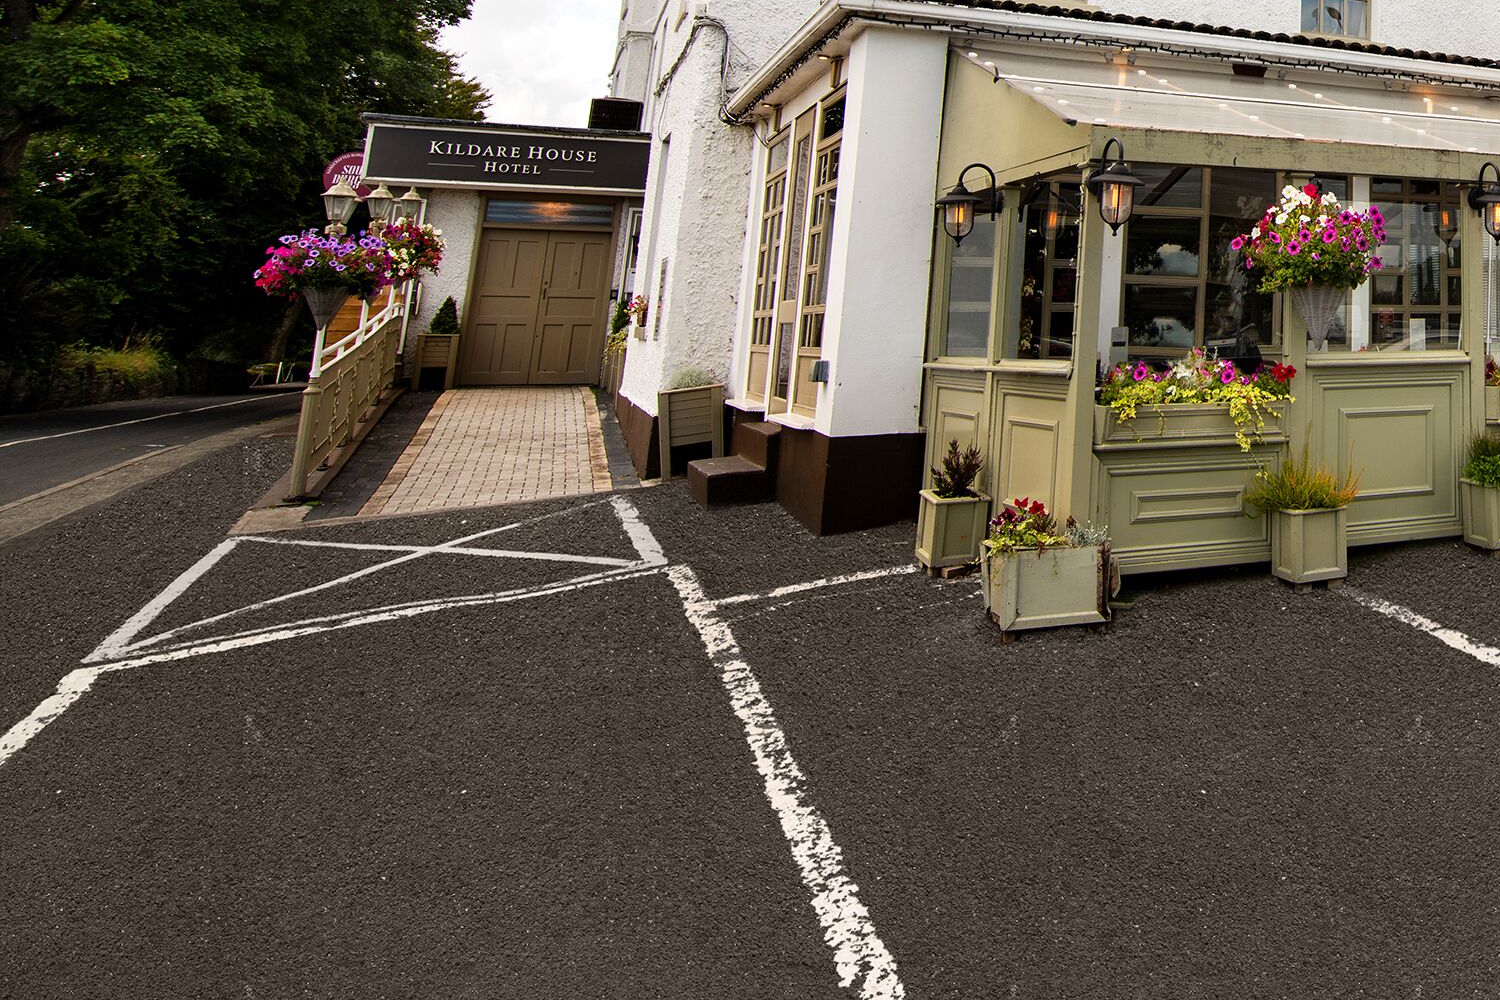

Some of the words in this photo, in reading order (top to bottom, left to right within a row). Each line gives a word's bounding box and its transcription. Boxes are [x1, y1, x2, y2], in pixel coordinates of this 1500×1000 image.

[429, 140, 521, 159] KILDARE
[527, 145, 597, 163] HOUSE
[483, 160, 541, 175] HOTEL
